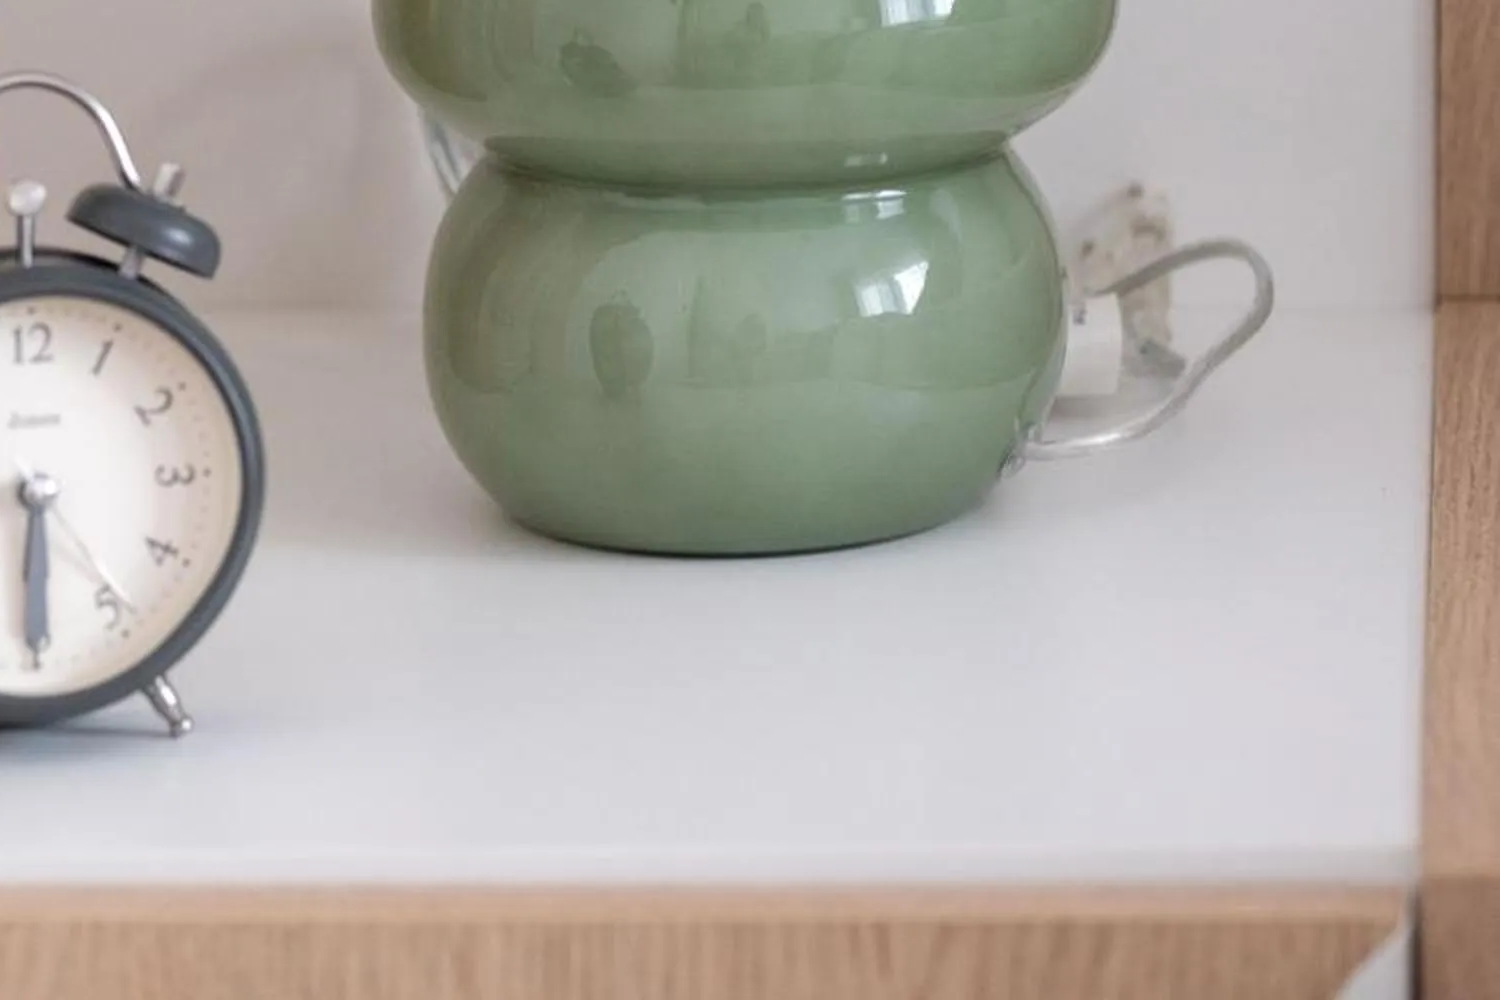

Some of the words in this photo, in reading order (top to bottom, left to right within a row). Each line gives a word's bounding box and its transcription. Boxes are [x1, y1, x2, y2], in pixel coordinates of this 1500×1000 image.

[11, 323, 54, 365] 12
[90, 339, 114, 376] 1
[134, 387, 173, 426] 2
[155, 464, 195, 489] 3
[144, 534, 180, 567] 4
[94, 584, 124, 632] 5
